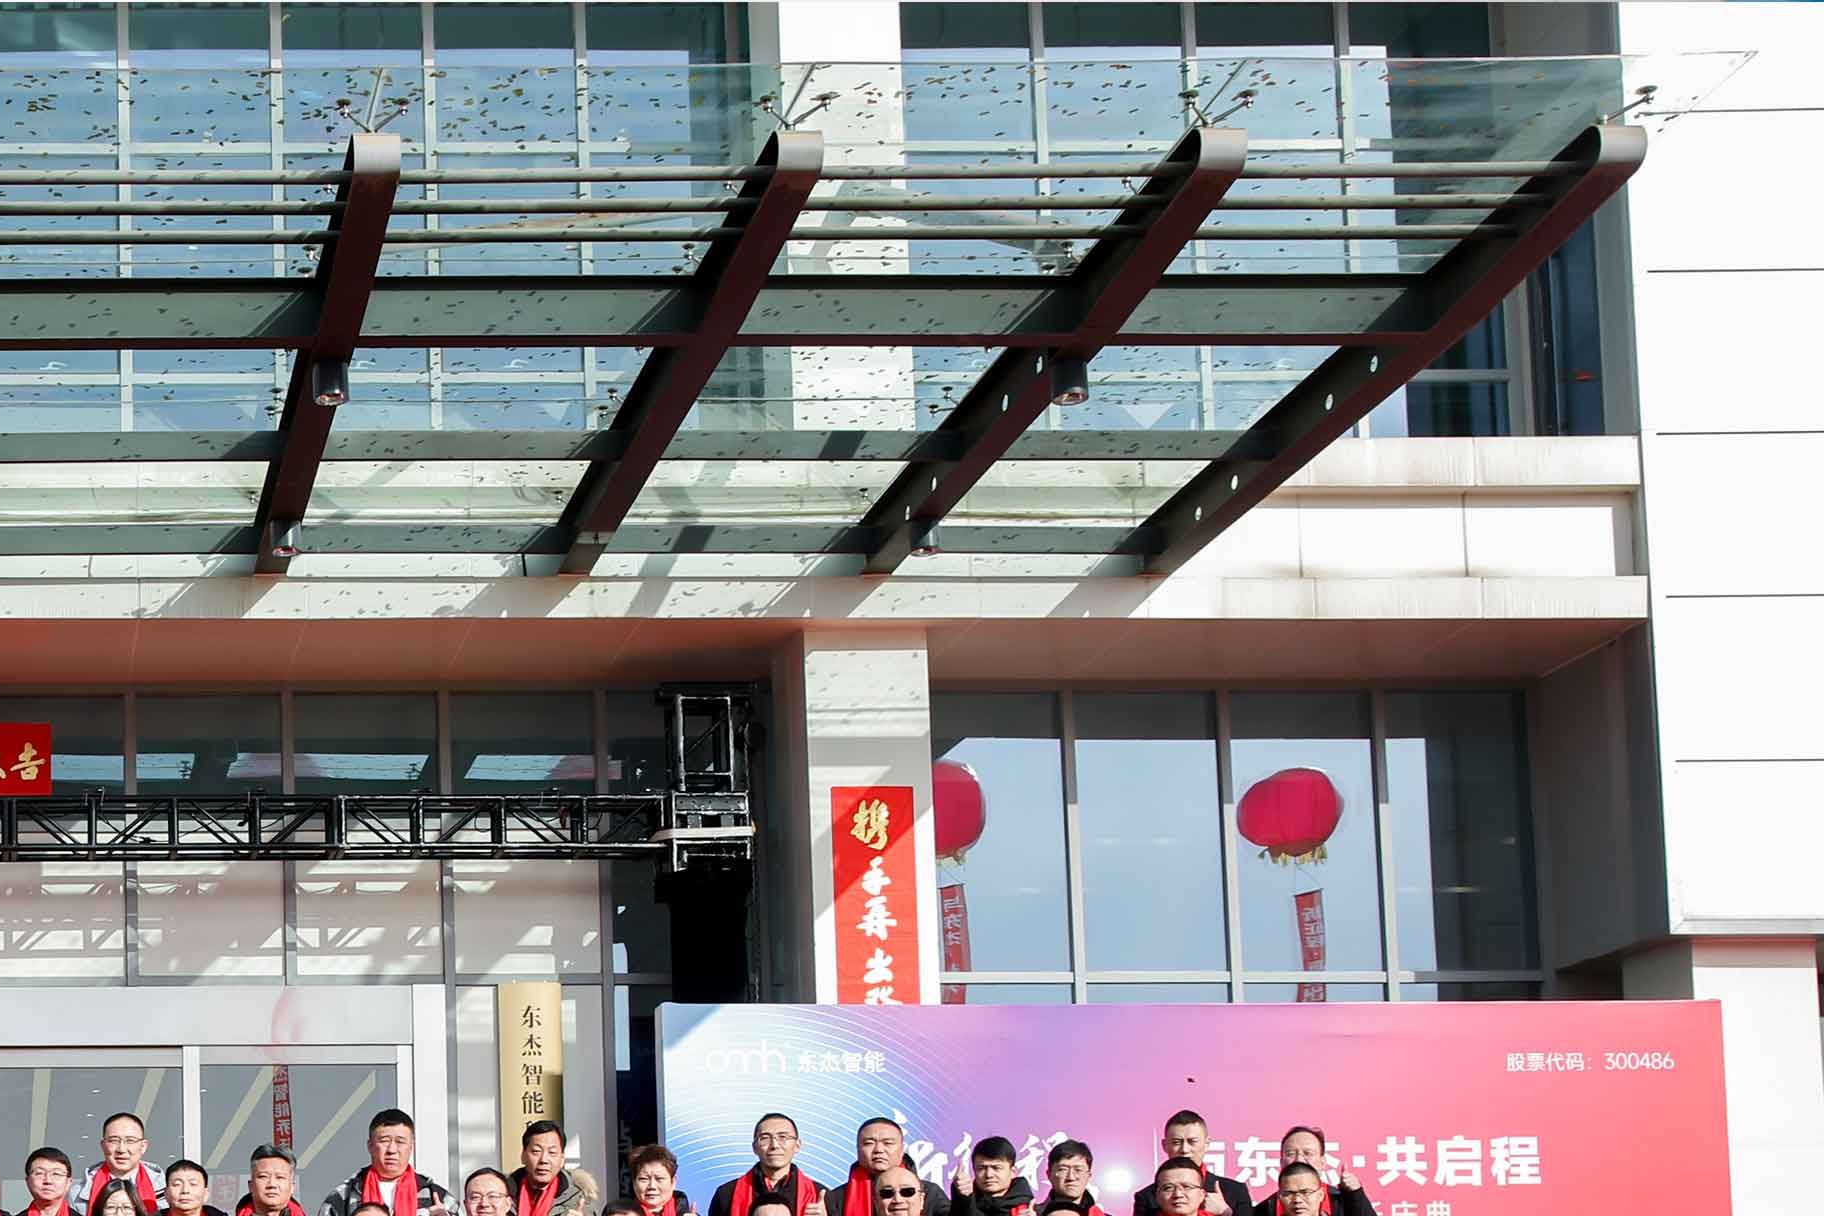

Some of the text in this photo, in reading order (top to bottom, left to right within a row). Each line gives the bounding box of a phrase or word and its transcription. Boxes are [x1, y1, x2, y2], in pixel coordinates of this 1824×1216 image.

[521, 1005, 545, 1127] 东杰智能
[797, 1050, 886, 1073] 东杰智能
